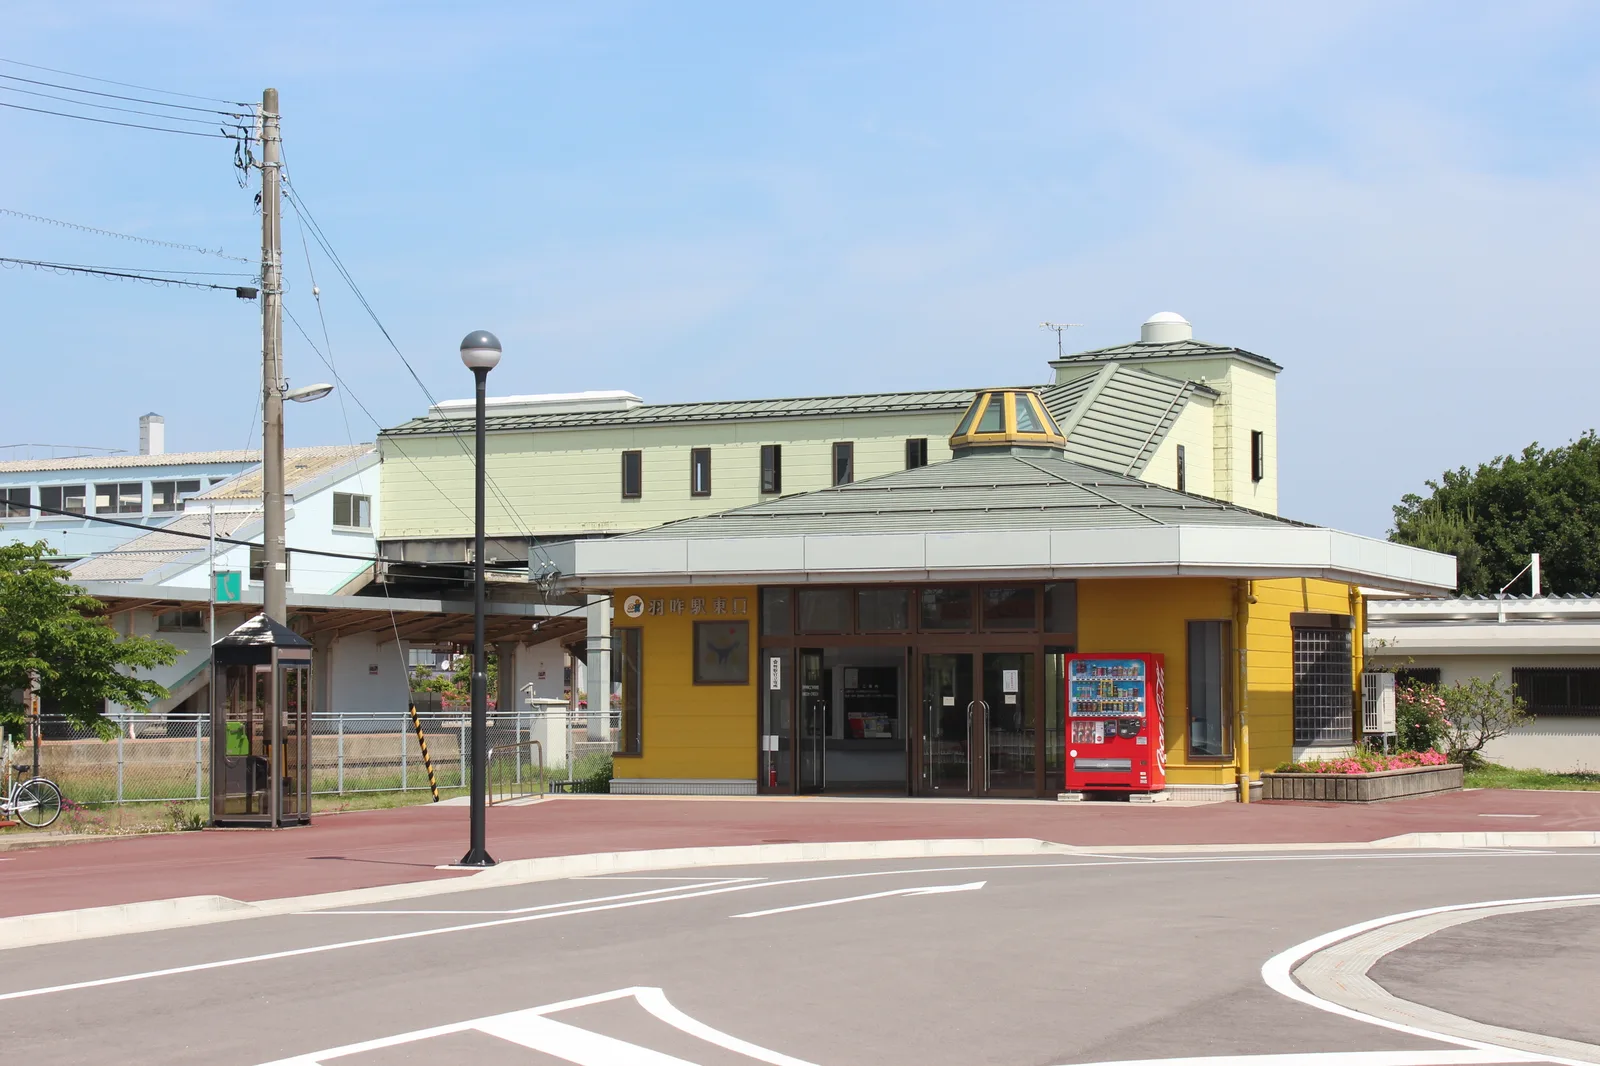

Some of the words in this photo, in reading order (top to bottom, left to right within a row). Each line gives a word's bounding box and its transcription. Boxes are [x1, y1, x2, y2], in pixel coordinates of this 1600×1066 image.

[648, 597, 747, 616] 羽咋駅東口
[1156, 660, 1165, 776] Coca-Cola
